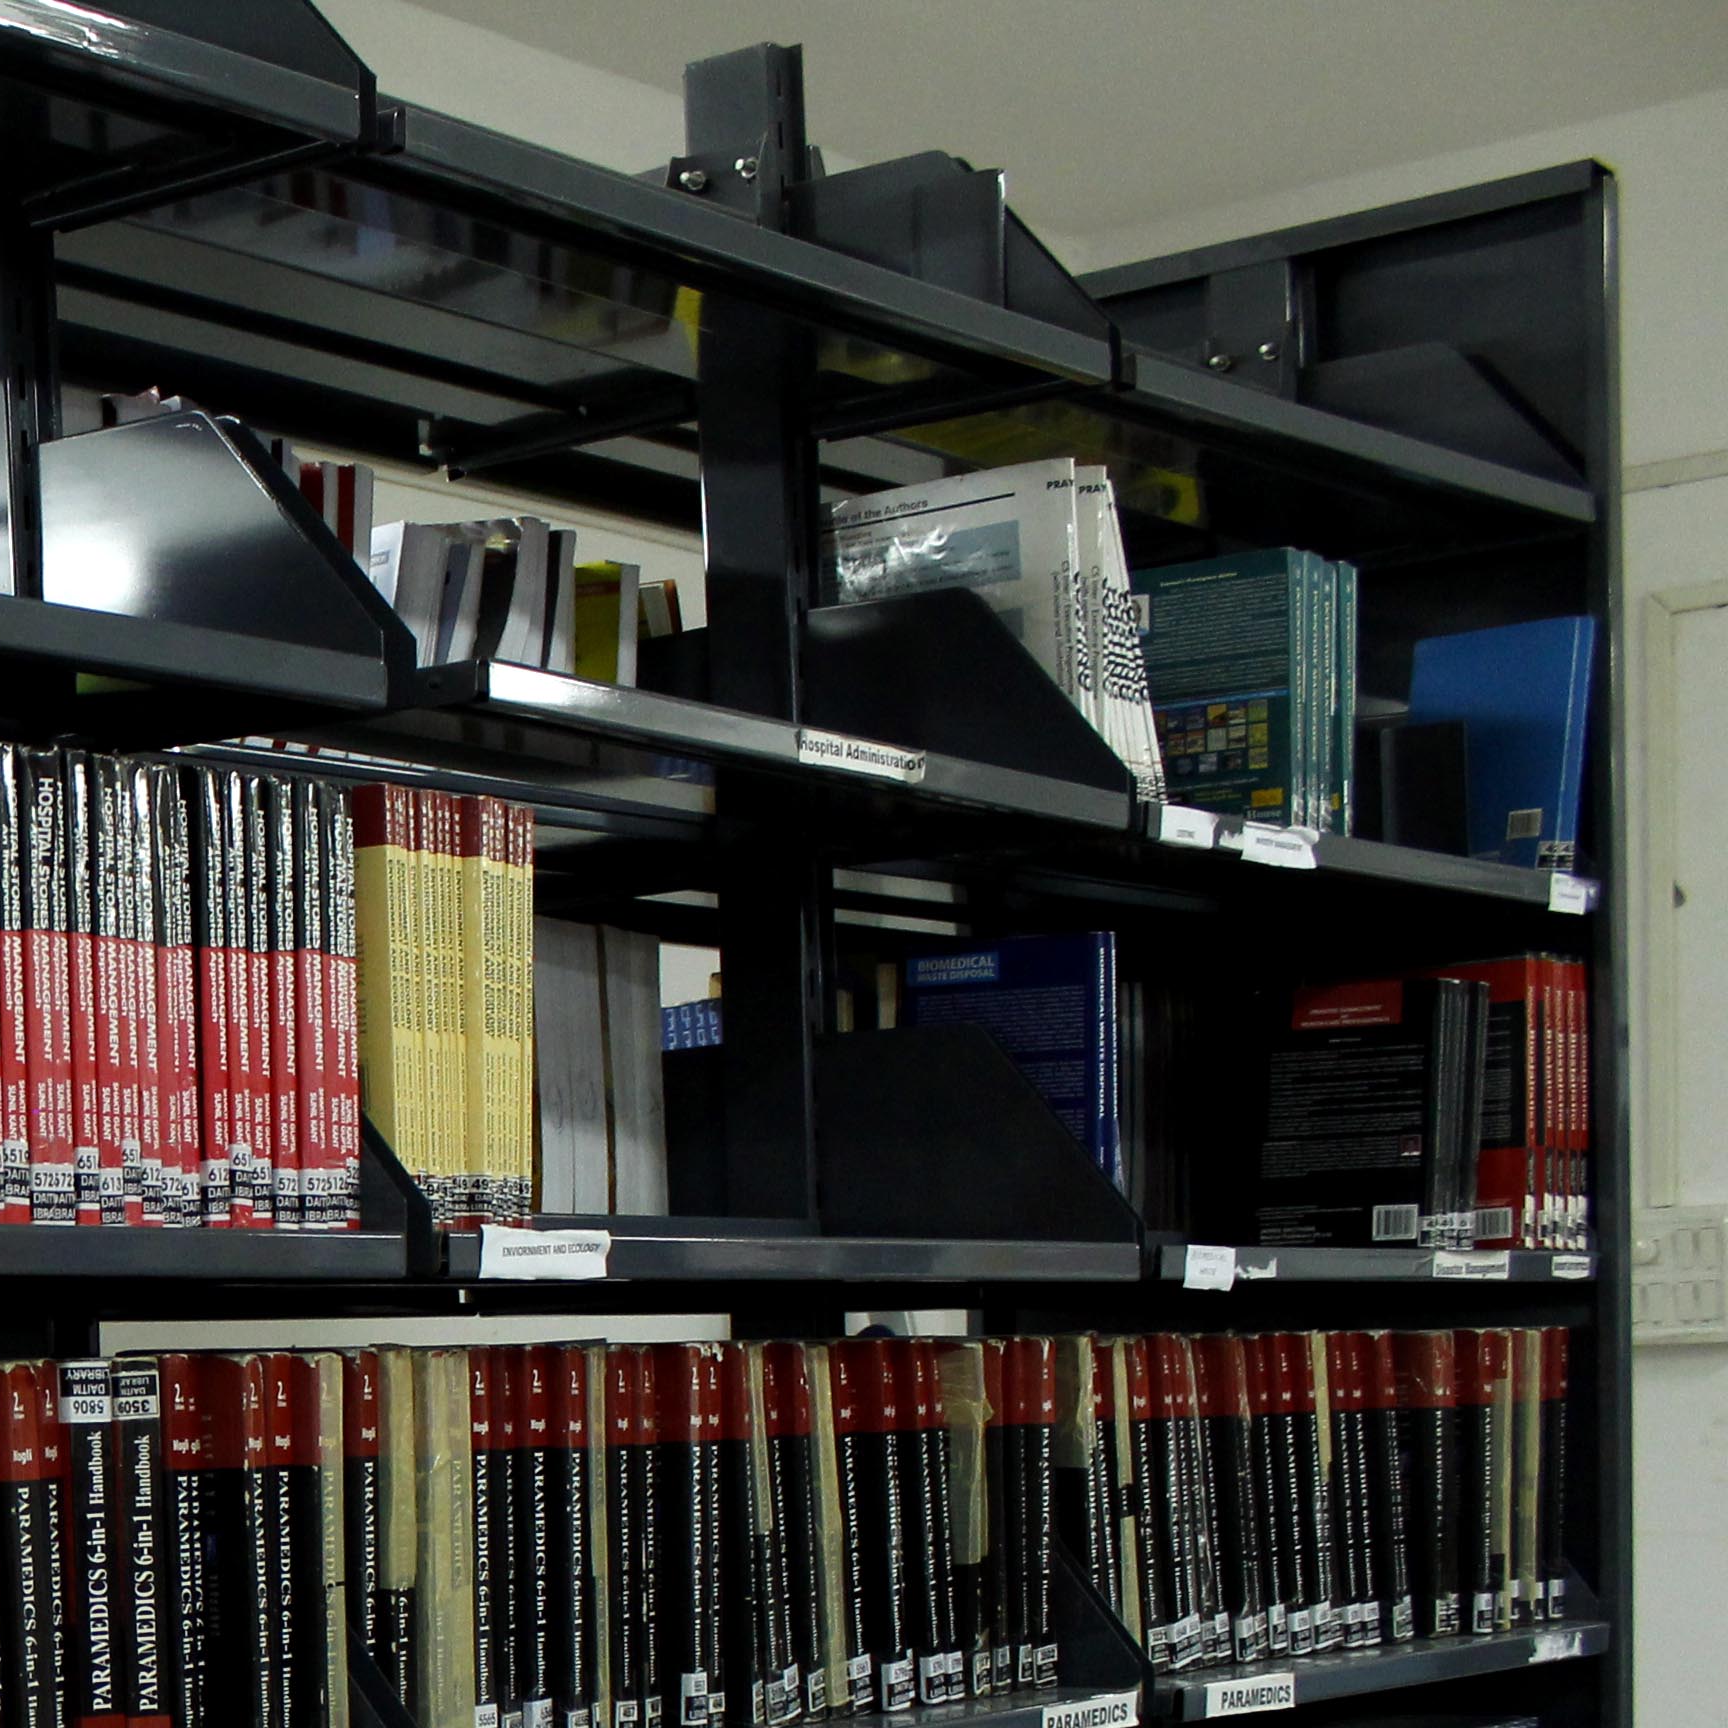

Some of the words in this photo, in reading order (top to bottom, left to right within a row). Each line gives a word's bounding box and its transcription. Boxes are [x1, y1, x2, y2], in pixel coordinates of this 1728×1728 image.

[885, 500, 928, 516] Authors
[36, 777, 53, 862] HOSPITAL
[918, 956, 994, 972] BIOMEDICAL
[41, 935, 54, 1062] MANAGEMENT
[554, 1244, 567, 1255] AND
[568, 1243, 600, 1254] ECOLOGY
[71, 1398, 103, 1416] 5806
[89, 1430, 104, 1505] Handbook
[87, 1509, 107, 1564] 6-in-1
[89, 1567, 113, 1713] PARAMEDICS
[1221, 1686, 1291, 1709] PARAMEDICS
